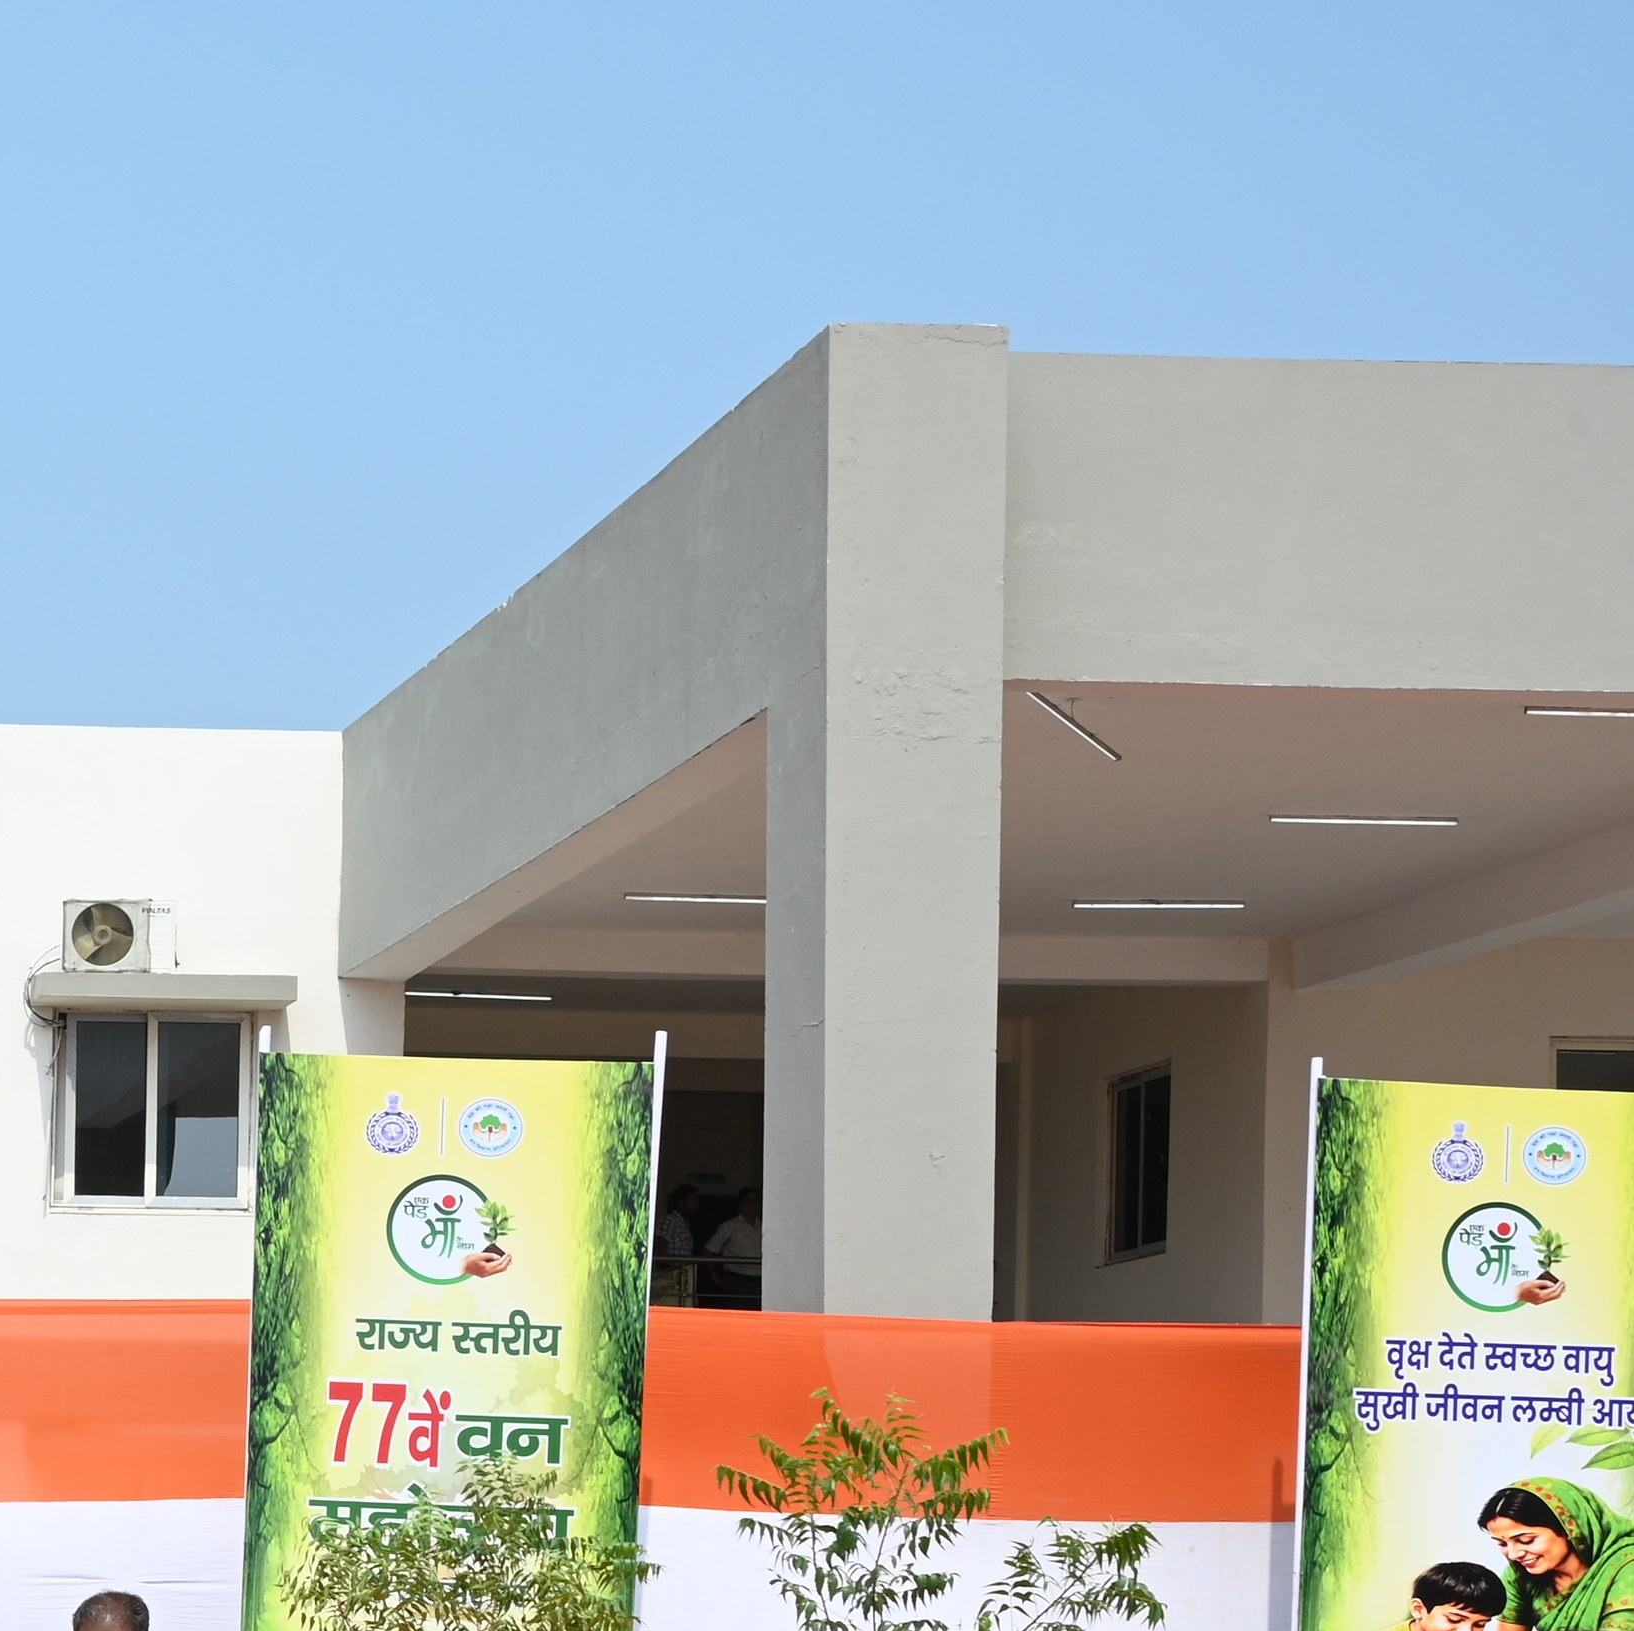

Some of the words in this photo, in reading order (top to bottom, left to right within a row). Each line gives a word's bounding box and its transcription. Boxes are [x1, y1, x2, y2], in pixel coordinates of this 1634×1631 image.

[355, 1317, 442, 1352] राज्य
[451, 1309, 562, 1357] स्तरीय
[1386, 1338, 1432, 1380] वृक्ष
[1438, 1332, 1478, 1371] देते
[1484, 1342, 1556, 1372] स्वच्छ
[1562, 1345, 1615, 1387] वायु
[328, 1381, 451, 1468] 77वें
[455, 1414, 570, 1465] वन
[1355, 1382, 1418, 1431] सुखी
[1425, 1383, 1505, 1423] जीवन
[1511, 1387, 1585, 1427] लम्बी
